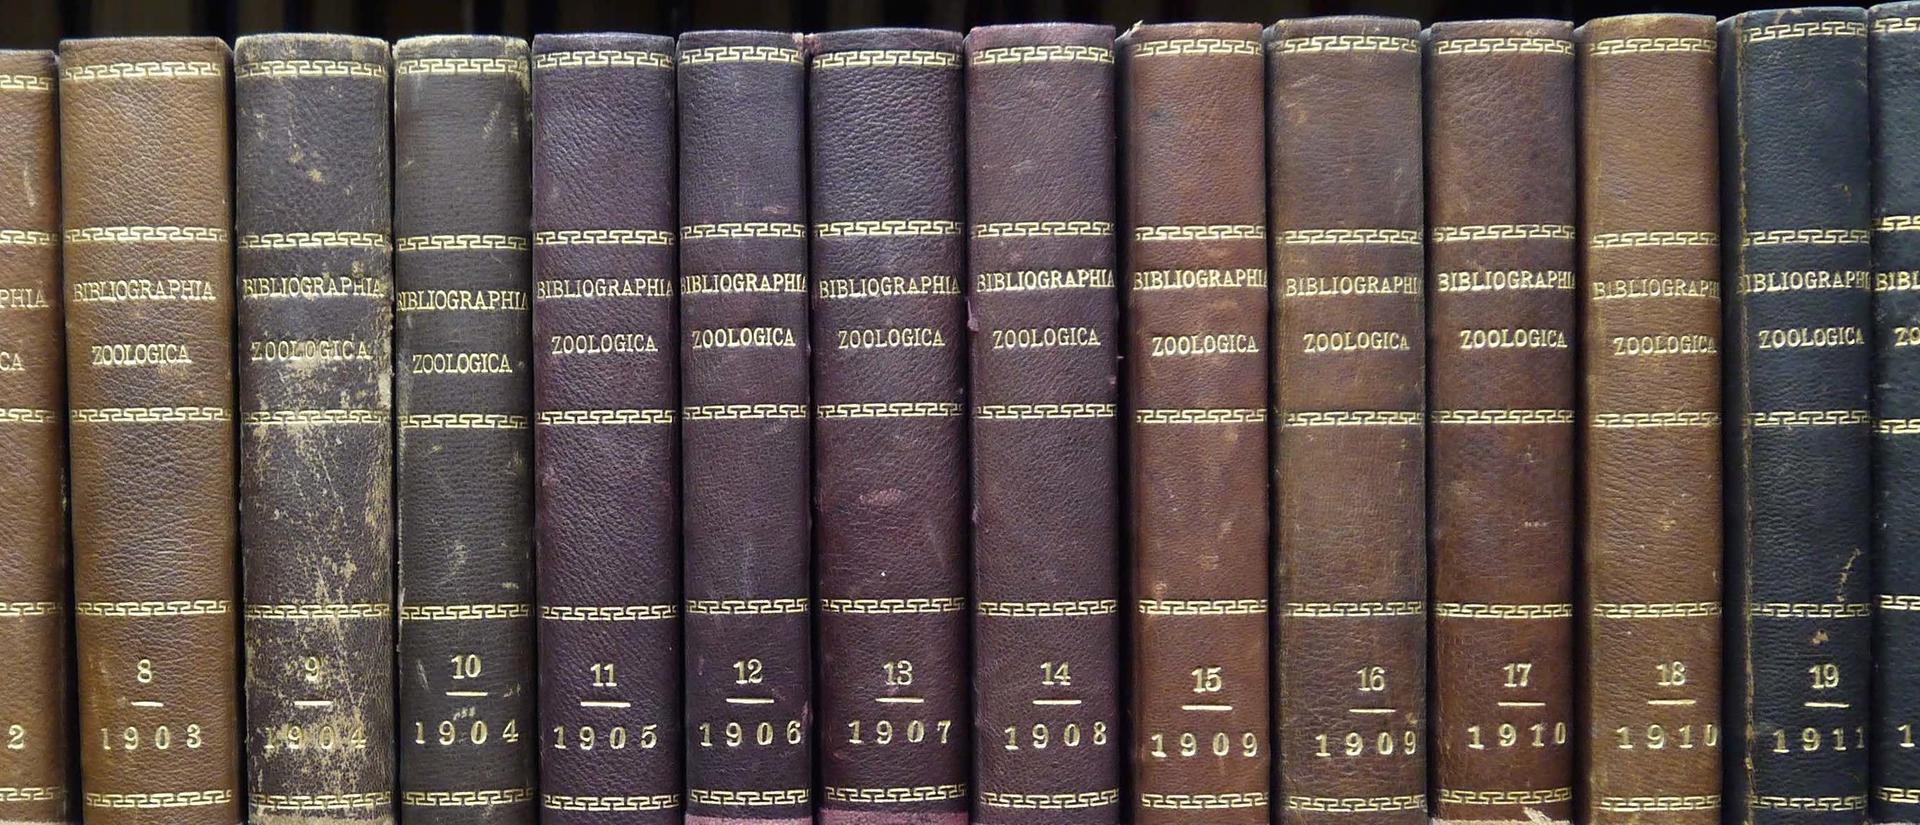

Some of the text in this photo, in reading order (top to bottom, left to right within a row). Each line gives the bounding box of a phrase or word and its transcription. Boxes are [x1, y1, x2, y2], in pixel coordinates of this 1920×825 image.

[73, 279, 216, 302] BIBLIOGRAPHIA
[242, 276, 385, 299] BIBLIOGRAPHIA
[537, 278, 674, 299] BIBLIOGRAPHIA
[681, 273, 808, 295] BIBLIOGRAPHIA
[819, 275, 961, 299] BIBLIOGRAPHIA
[977, 269, 1116, 292] BIBLIOGRAPHIA
[1286, 276, 1418, 296] BIBLIOGRAPHI
[1593, 278, 1721, 300] BIBLIOGRAPHI
[1737, 270, 1871, 295] BIBLIOGRAPHI
[551, 333, 659, 355] ZOOLOGICA
[691, 326, 797, 349] ZOOLOGICA
[837, 328, 946, 350] ZOOLOGICA
[992, 326, 1101, 349] ZOOLOGICA
[1151, 334, 1260, 357] ZOOLOGICA
[1303, 331, 1411, 353] ZOOLOGICA
[1460, 329, 1568, 350] ZOOLOGICA
[1613, 334, 1718, 357] ZOOLOGICA
[1758, 327, 1866, 350] ZOOLOGICA
[91, 343, 193, 366] ZOOLOGICA
[251, 340, 373, 361] ZOOLOGICA
[412, 353, 513, 374] ZOOLOGICA
[136, 658, 152, 683] 8
[304, 656, 321, 682] 9
[450, 654, 482, 680] 10
[590, 663, 618, 687] 11
[732, 658, 763, 685] 12
[882, 660, 914, 686] 13
[1039, 661, 1072, 686] 14
[1503, 662, 1532, 688] 17
[1656, 661, 1687, 687] 18
[1808, 663, 1841, 689] 19
[1191, 666, 1223, 693] 15
[1356, 666, 1386, 692] 16
